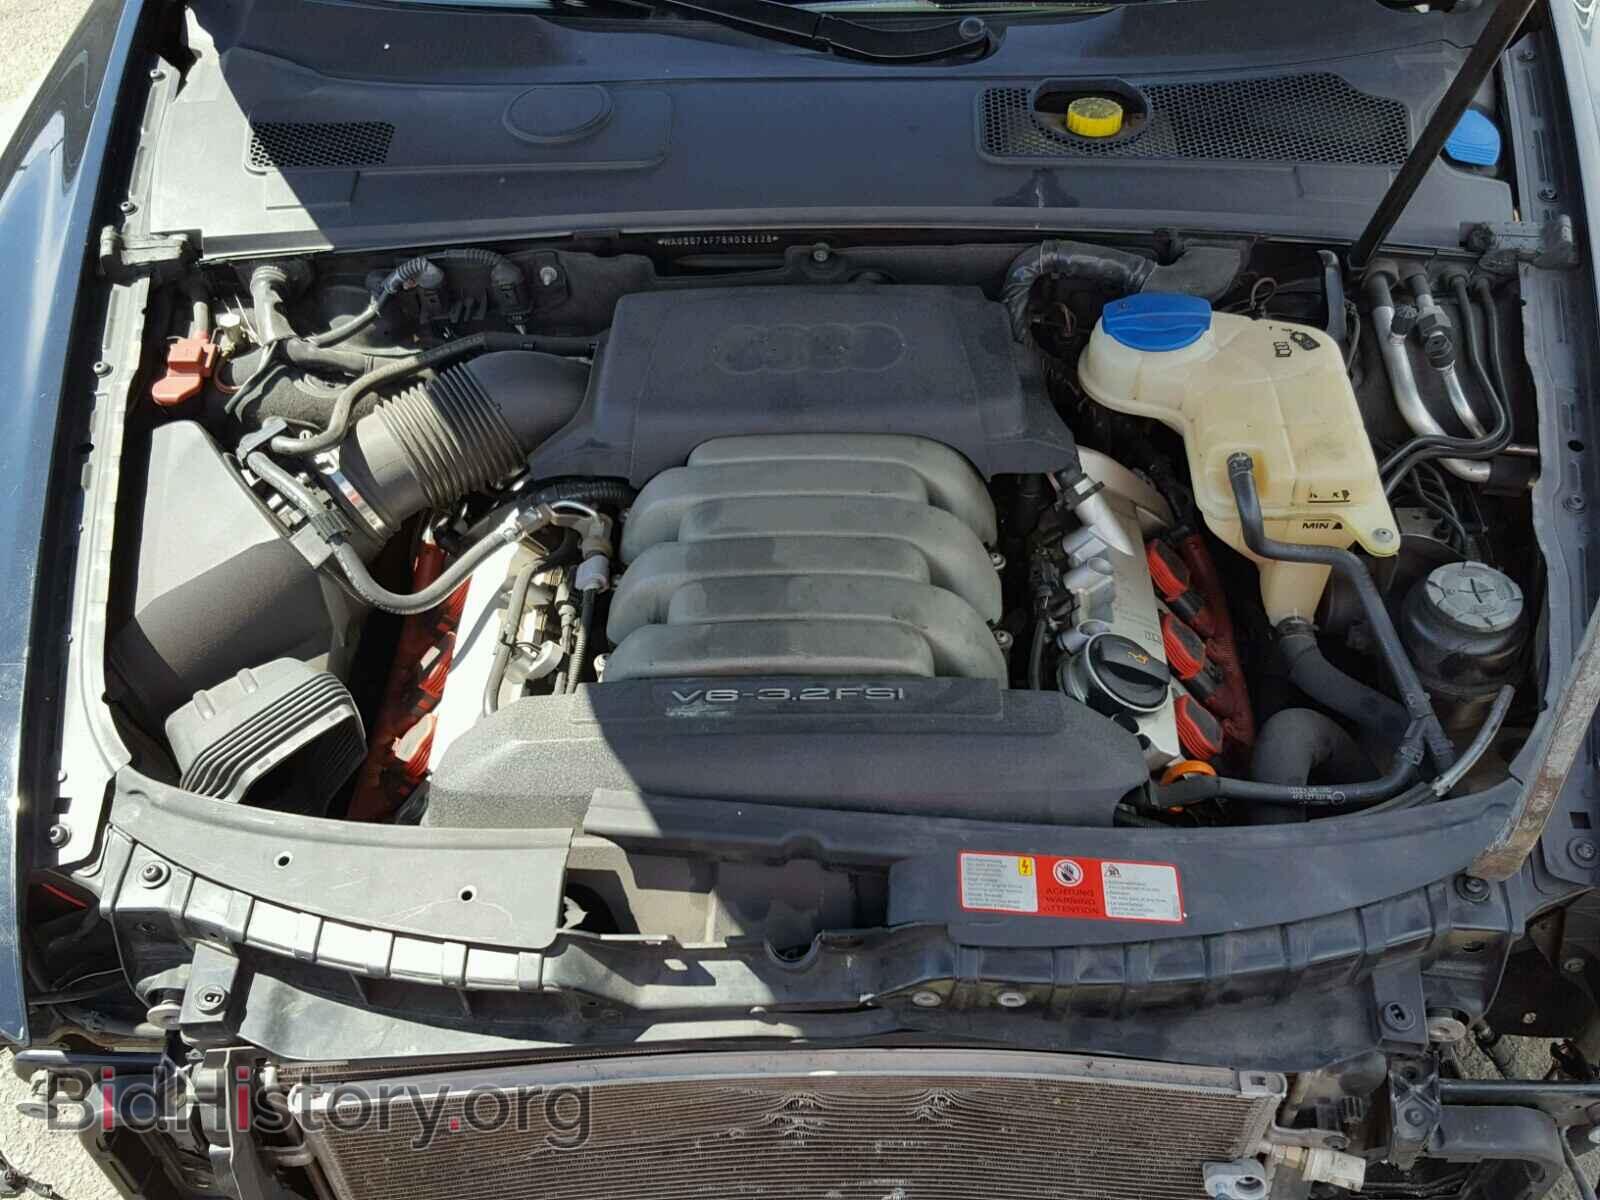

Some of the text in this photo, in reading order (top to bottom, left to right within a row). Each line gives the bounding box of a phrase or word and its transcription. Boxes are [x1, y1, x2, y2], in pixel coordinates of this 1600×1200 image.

[672, 687, 904, 701] V6-3.2FSI
[1046, 888, 1094, 897] ACHTUNG
[1046, 897, 1096, 905] WARNING
[1043, 905, 1099, 914] ATTENTION
